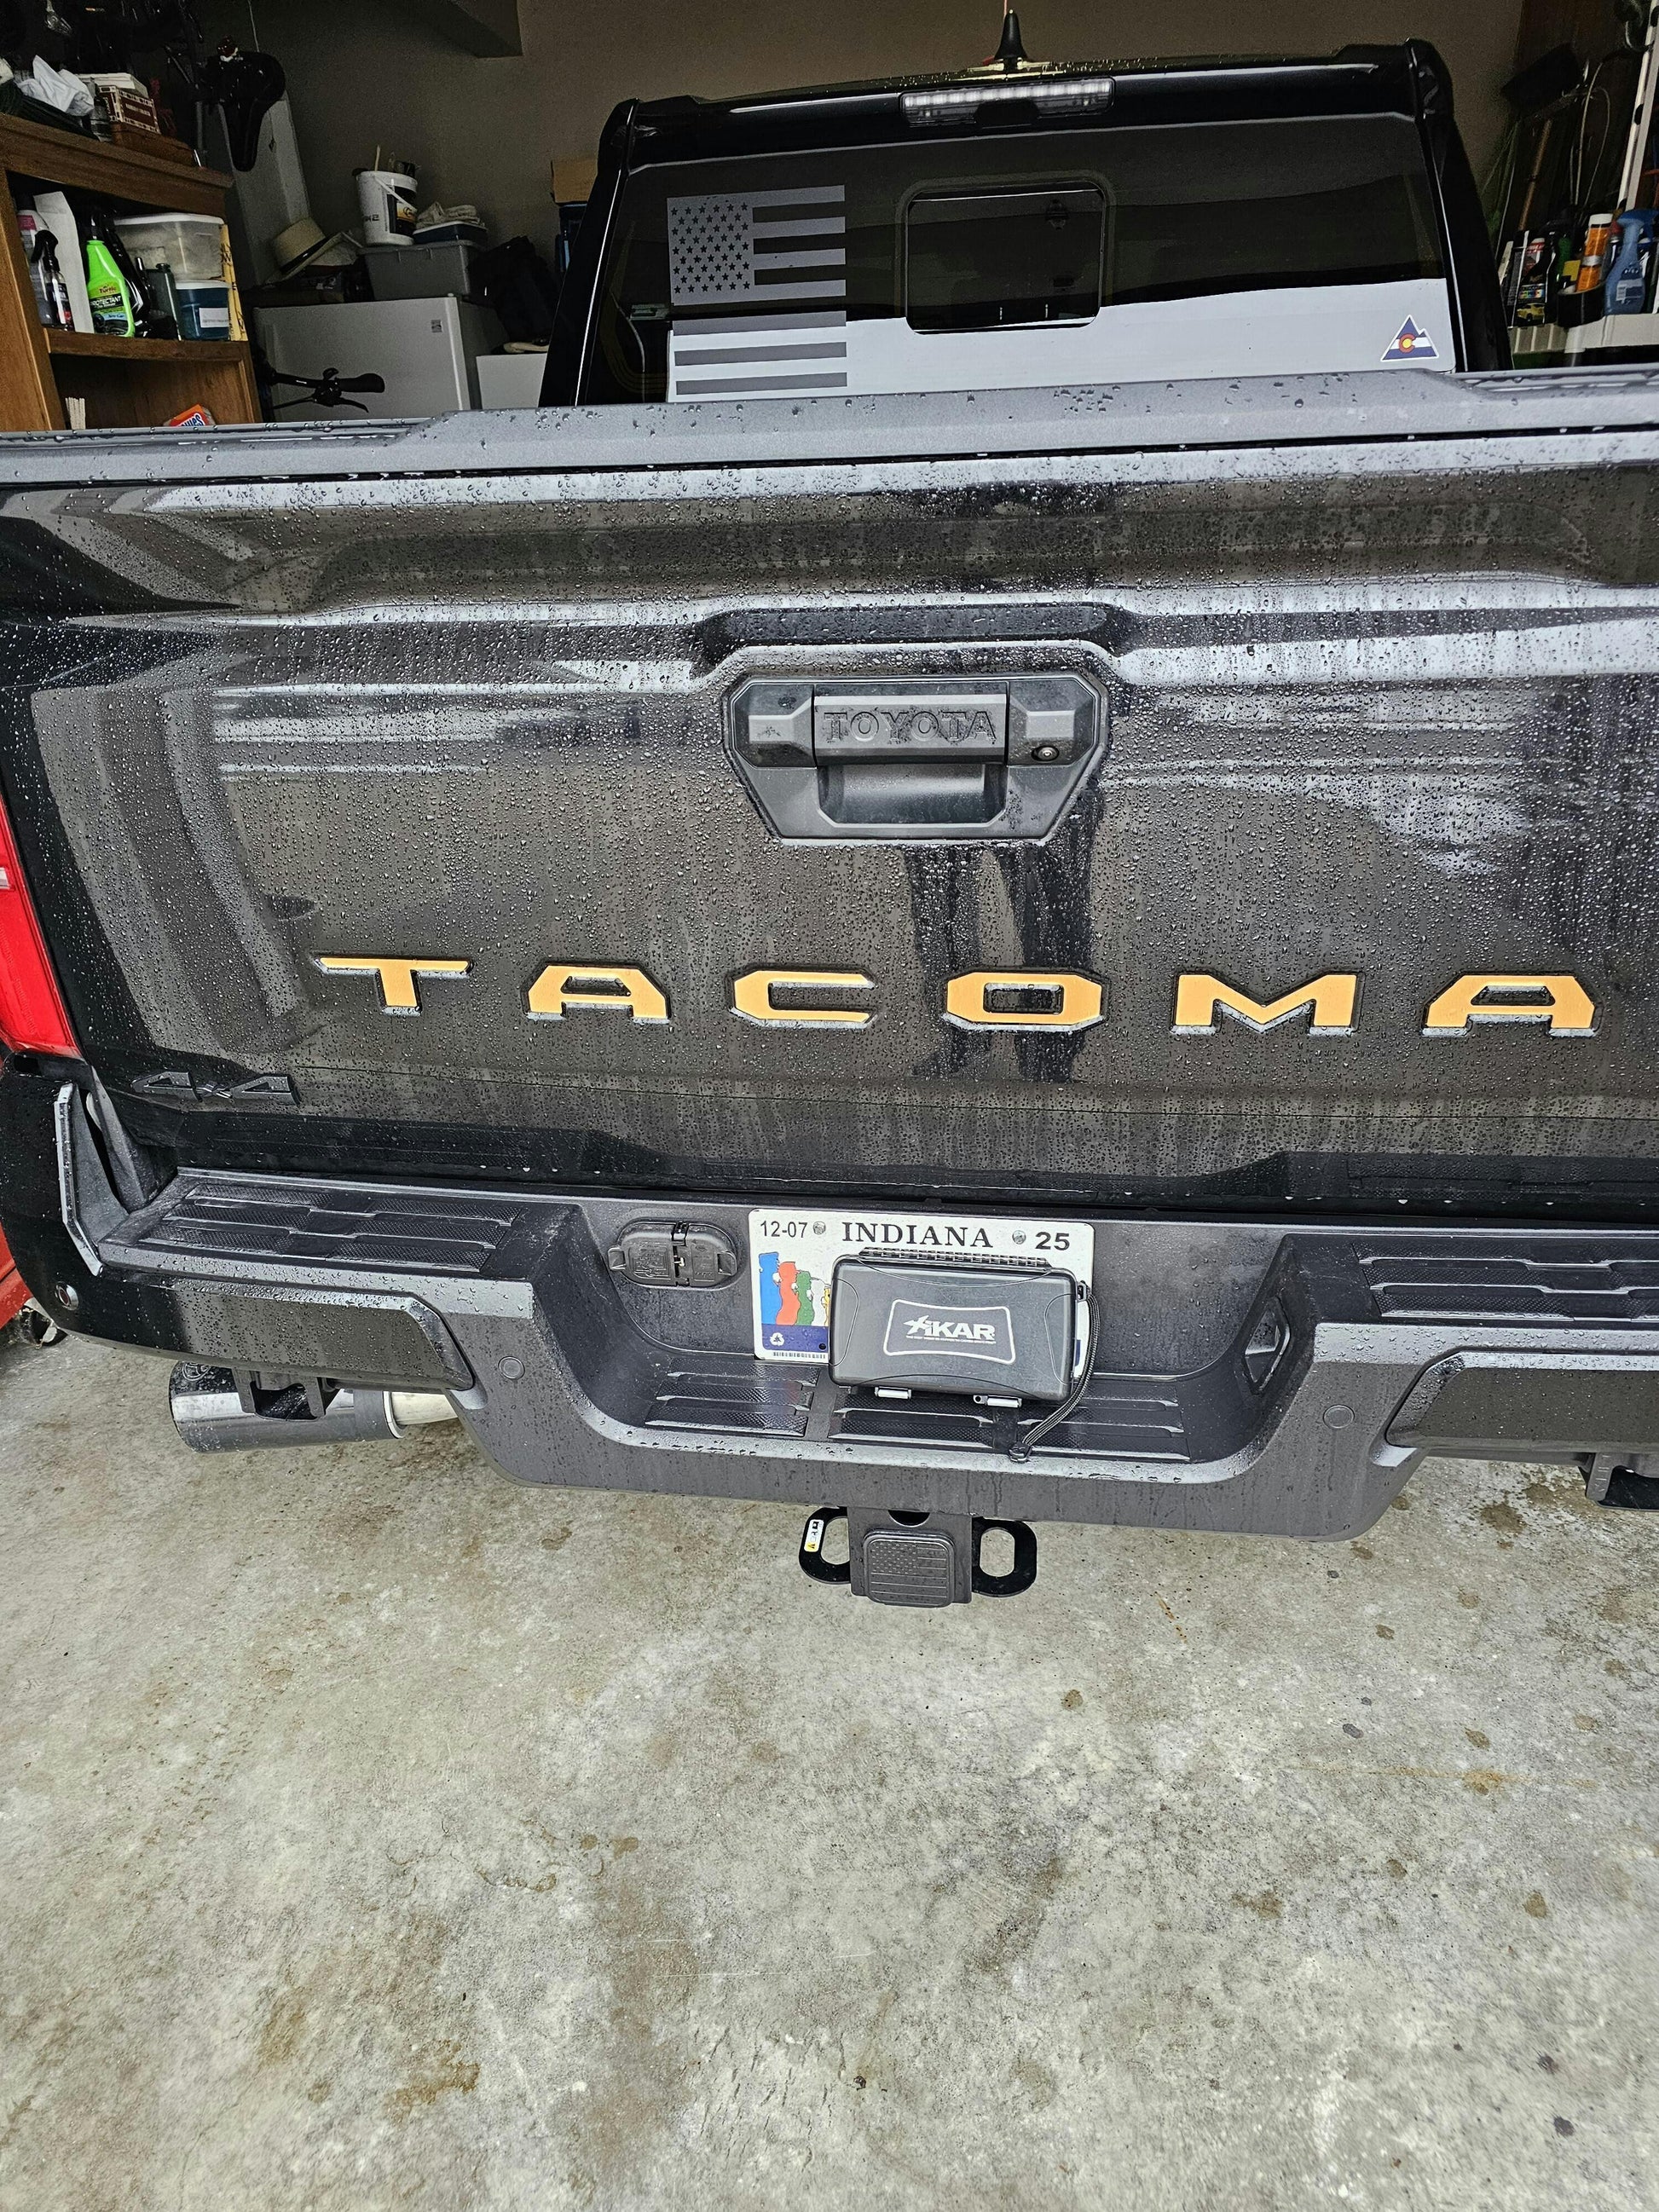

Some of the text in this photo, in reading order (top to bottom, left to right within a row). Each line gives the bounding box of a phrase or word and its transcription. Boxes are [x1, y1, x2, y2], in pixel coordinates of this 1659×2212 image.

[824, 711, 997, 742] TOYOTA
[316, 955, 1597, 1037] TACOMA
[760, 1220, 808, 1239] 12-07
[841, 1222, 993, 1248] INDIANA
[1034, 1231, 1070, 1251] 25
